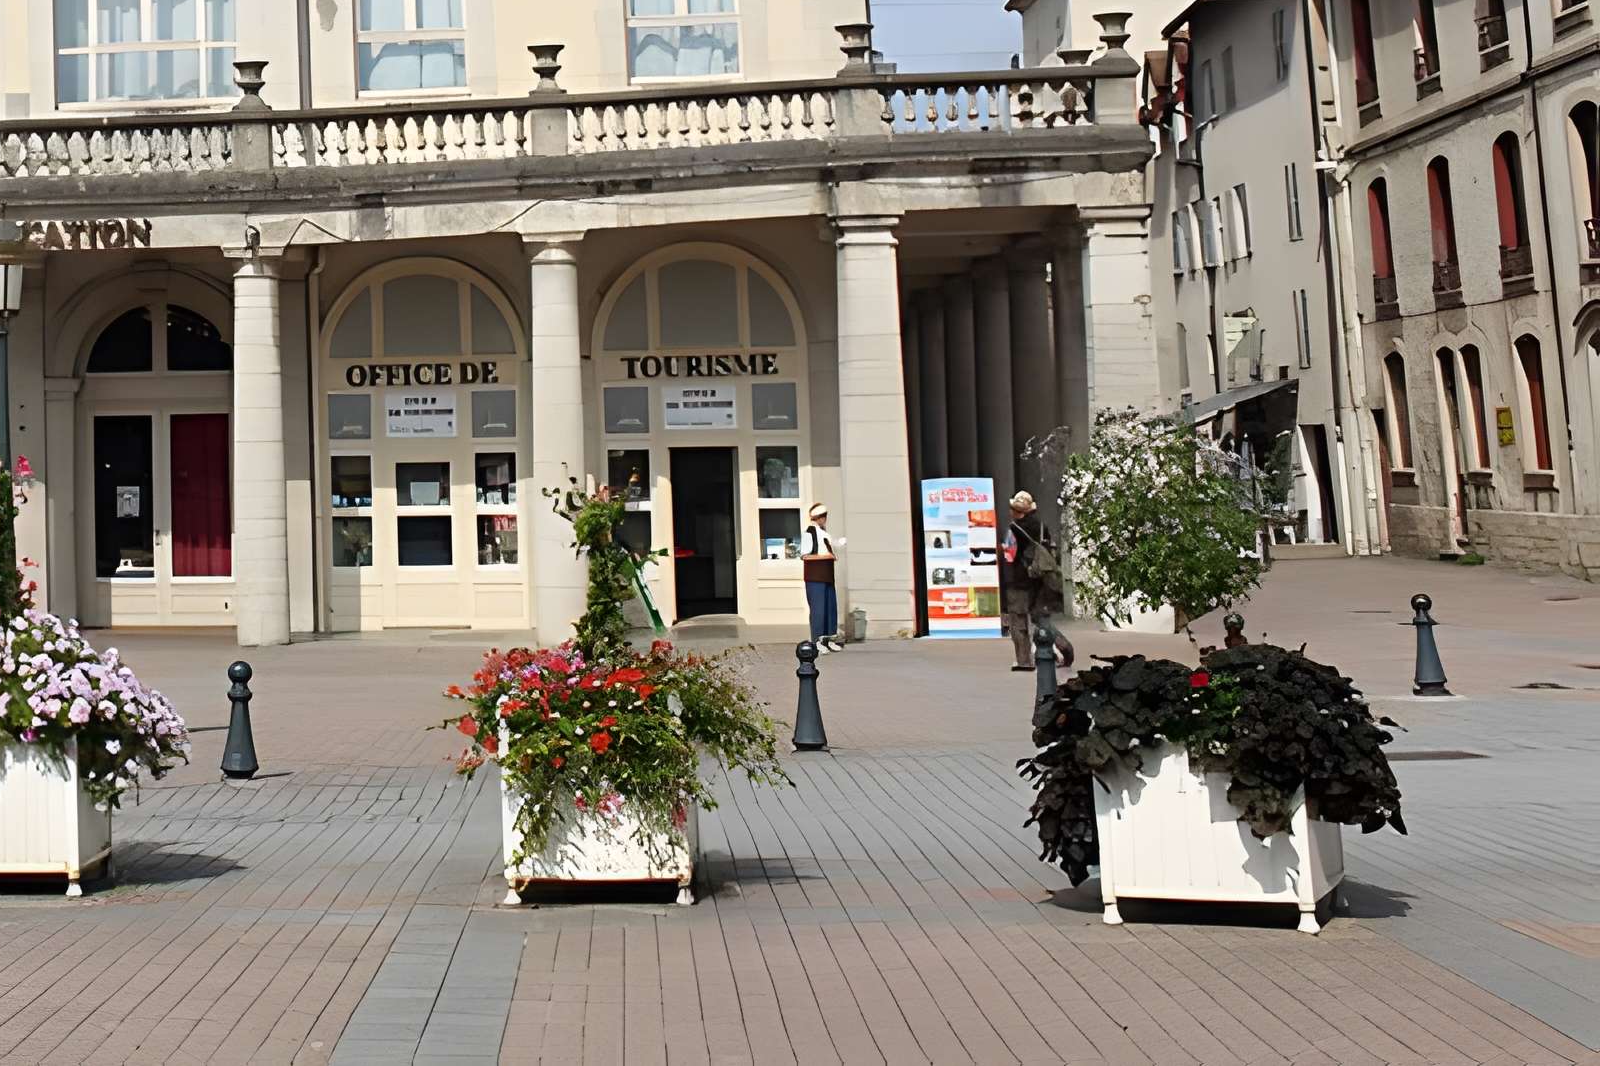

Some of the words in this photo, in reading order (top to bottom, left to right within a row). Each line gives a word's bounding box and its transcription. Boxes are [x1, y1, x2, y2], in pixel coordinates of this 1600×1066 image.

[345, 363, 453, 387] OFFICE
[459, 361, 500, 385] DE
[619, 353, 780, 380] TOURISME
